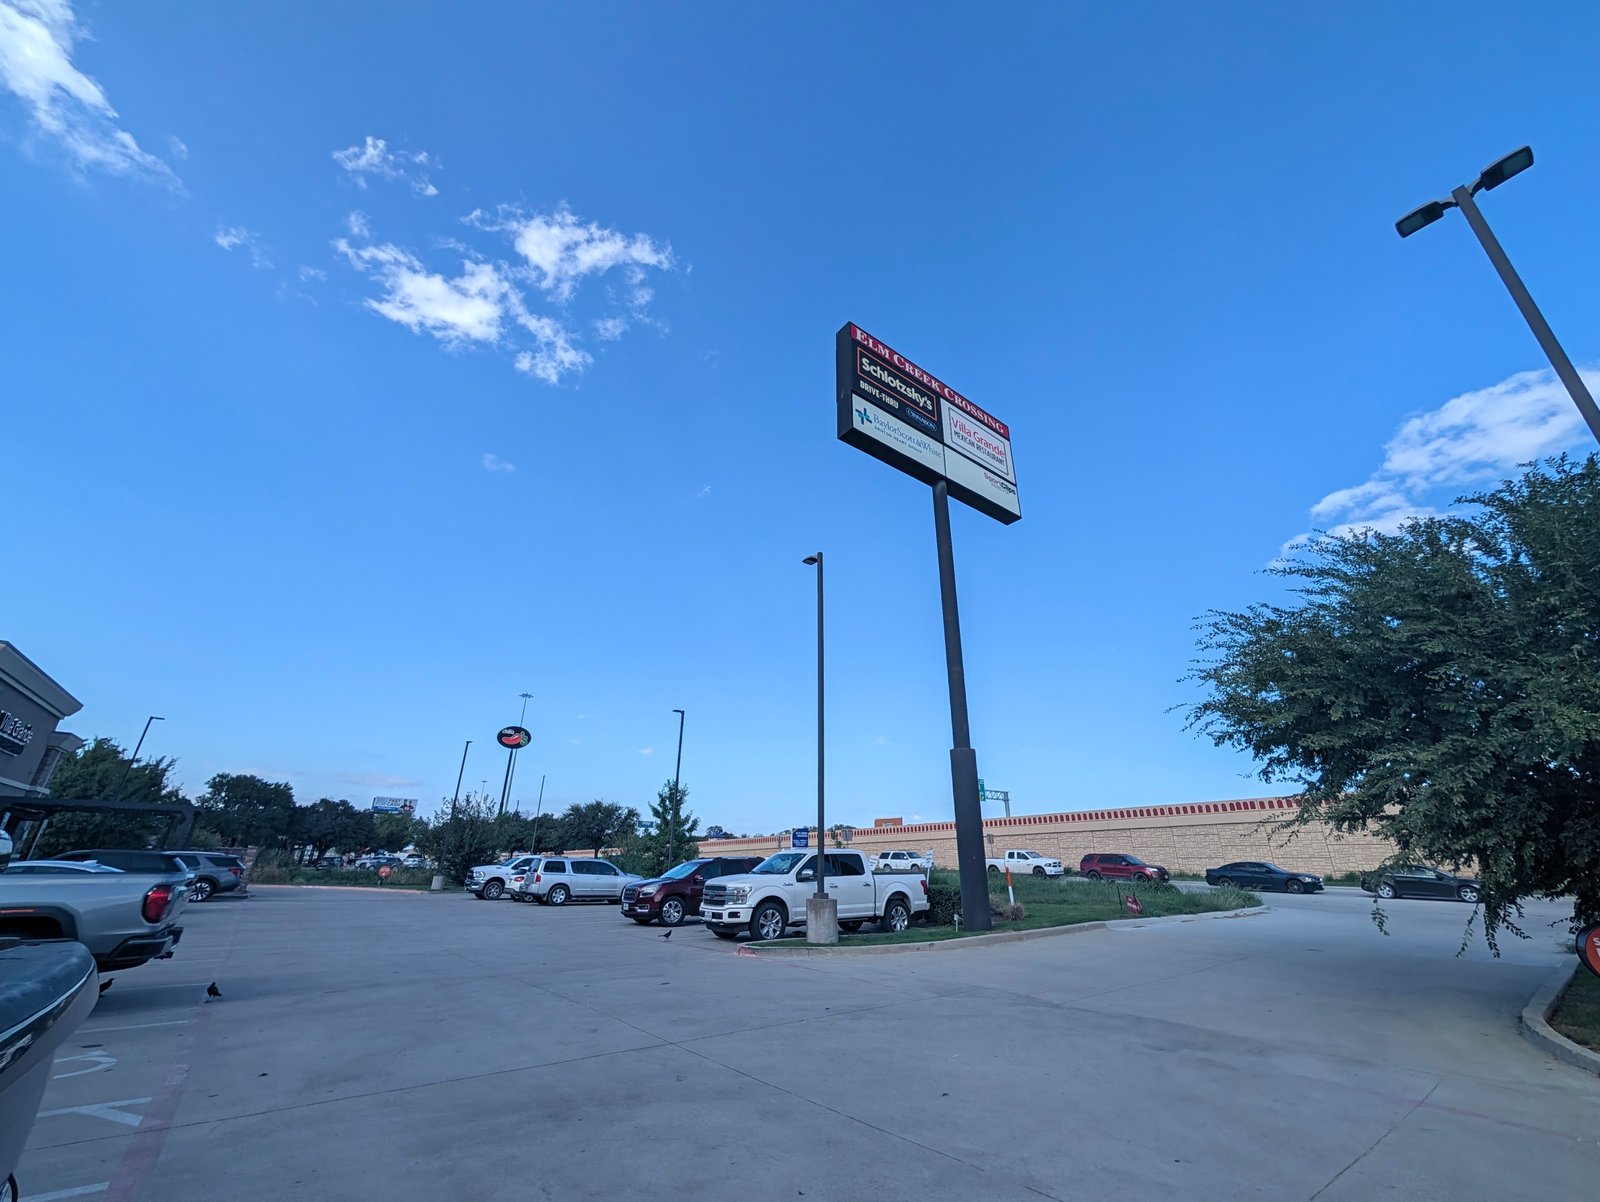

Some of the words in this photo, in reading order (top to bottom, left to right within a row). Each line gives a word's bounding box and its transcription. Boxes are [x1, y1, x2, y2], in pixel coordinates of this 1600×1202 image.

[855, 327, 890, 360] ELM
[893, 354, 941, 393] CREEK
[944, 387, 1004, 433] CROSSING
[859, 379, 899, 409] DRIVE-THRU
[861, 357, 933, 410] Schlotzsky's
[951, 416, 972, 437] Villa
[973, 431, 1005, 458] Grande
[953, 430, 976, 448] MEXICAN
[975, 443, 1005, 466] RESTAURANT
